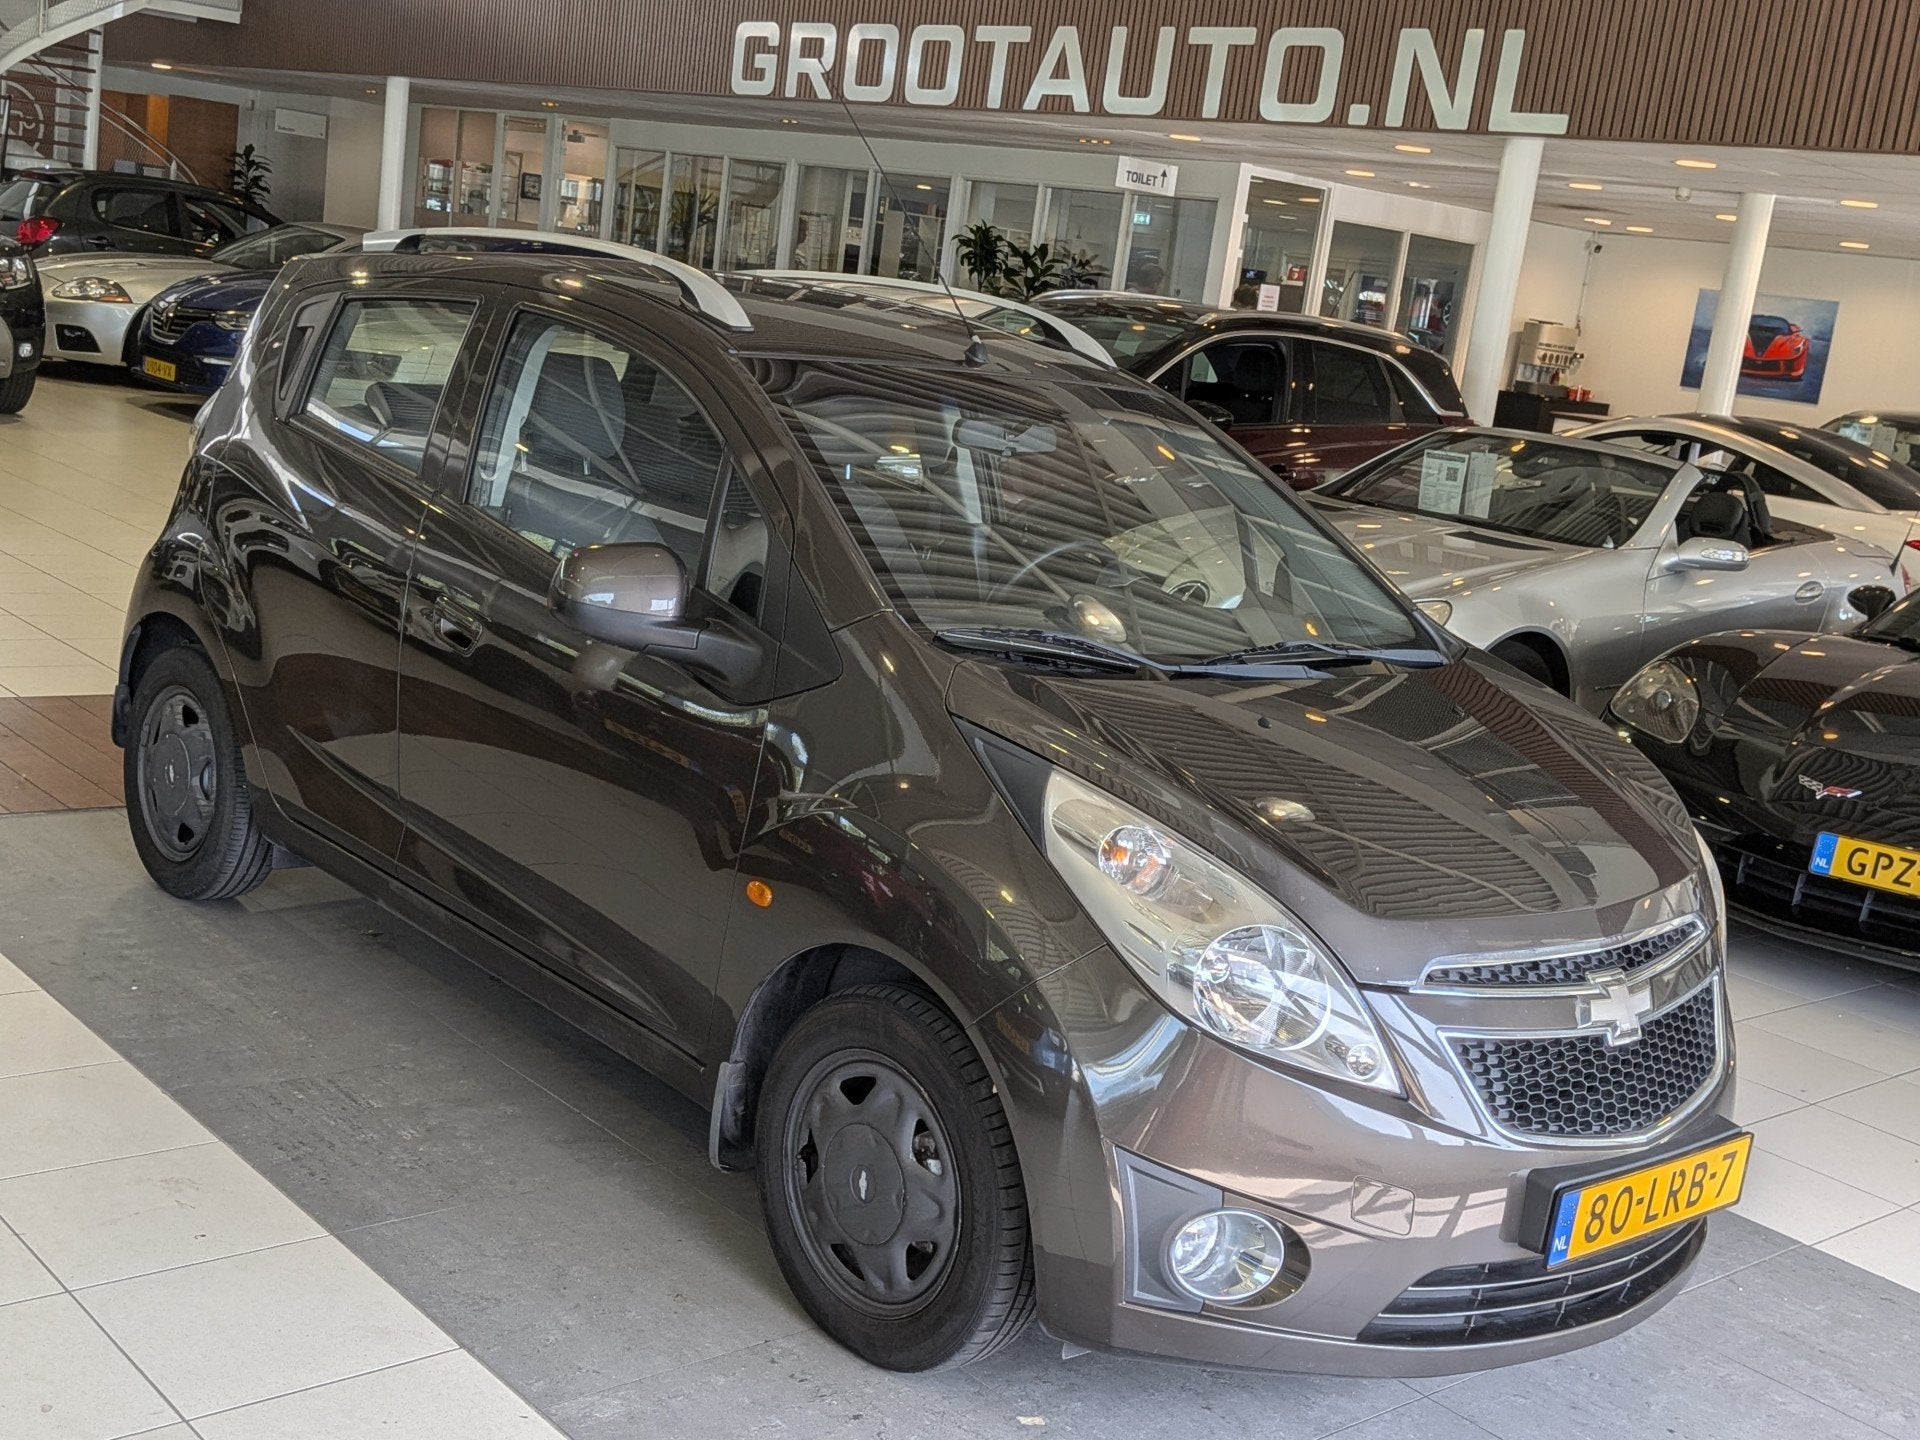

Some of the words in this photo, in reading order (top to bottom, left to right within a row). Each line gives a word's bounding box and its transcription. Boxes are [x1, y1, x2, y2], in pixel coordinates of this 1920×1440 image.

[731, 21, 1569, 135] GROOTAUTO.NL
[1125, 170, 1158, 187] TOILET
[1814, 856, 1829, 868] NL
[1846, 847, 1920, 888] GPZ
[1552, 1235, 1568, 1252] NL
[1584, 1150, 1738, 1244] 80-LRB-7
